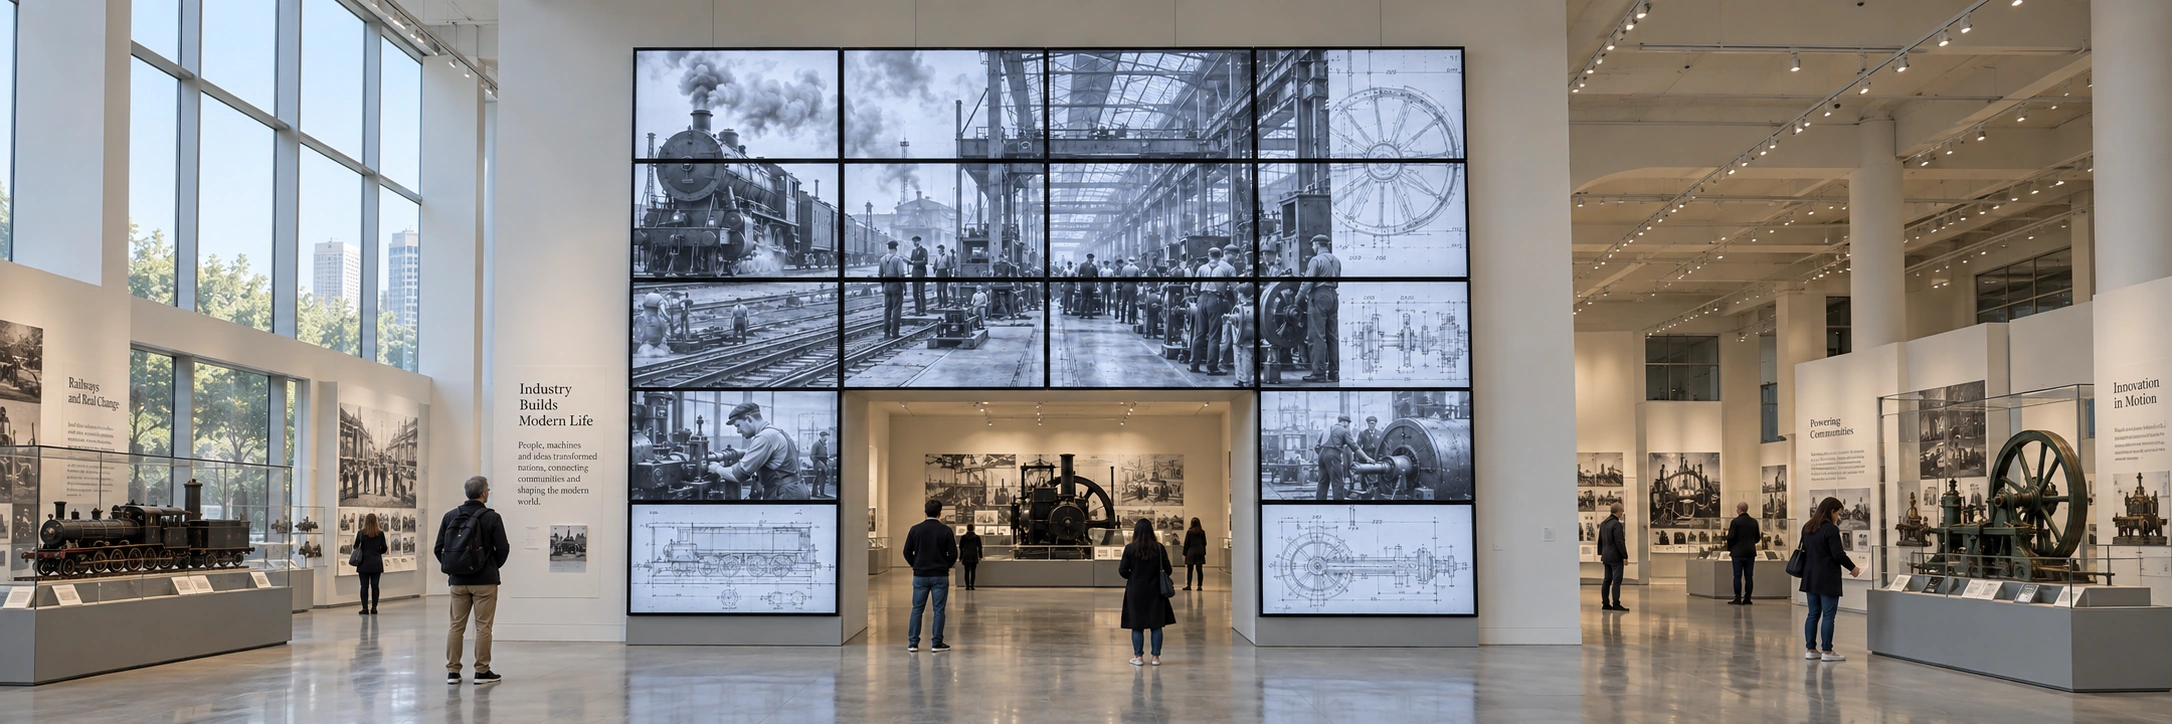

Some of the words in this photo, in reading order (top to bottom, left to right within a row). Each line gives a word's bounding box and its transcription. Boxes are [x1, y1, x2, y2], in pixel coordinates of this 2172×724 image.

[520, 383, 572, 397] Industry
[2113, 377, 2160, 394] Innovation
[68, 393, 81, 404] and
[82, 394, 97, 406] Real
[519, 398, 558, 411] Builds
[2114, 397, 2123, 409] in
[2125, 393, 2157, 407] Motion
[519, 414, 566, 426] Modern
[569, 414, 594, 426] Life
[1810, 417, 1841, 427] Powering
[1810, 427, 1854, 439] Communities
[518, 441, 545, 451] People,
[546, 441, 582, 449] machines
[517, 452, 532, 461] and
[533, 452, 551, 461] ideas
[553, 452, 598, 461] transformed
[517, 464, 546, 472] nations,
[547, 464, 589, 473] connecting
[517, 475, 565, 483] communities
[566, 475, 581, 483] and
[517, 486, 546, 496] shaping
[547, 486, 559, 494] the
[560, 486, 589, 494] modern
[517, 497, 541, 506] world.
